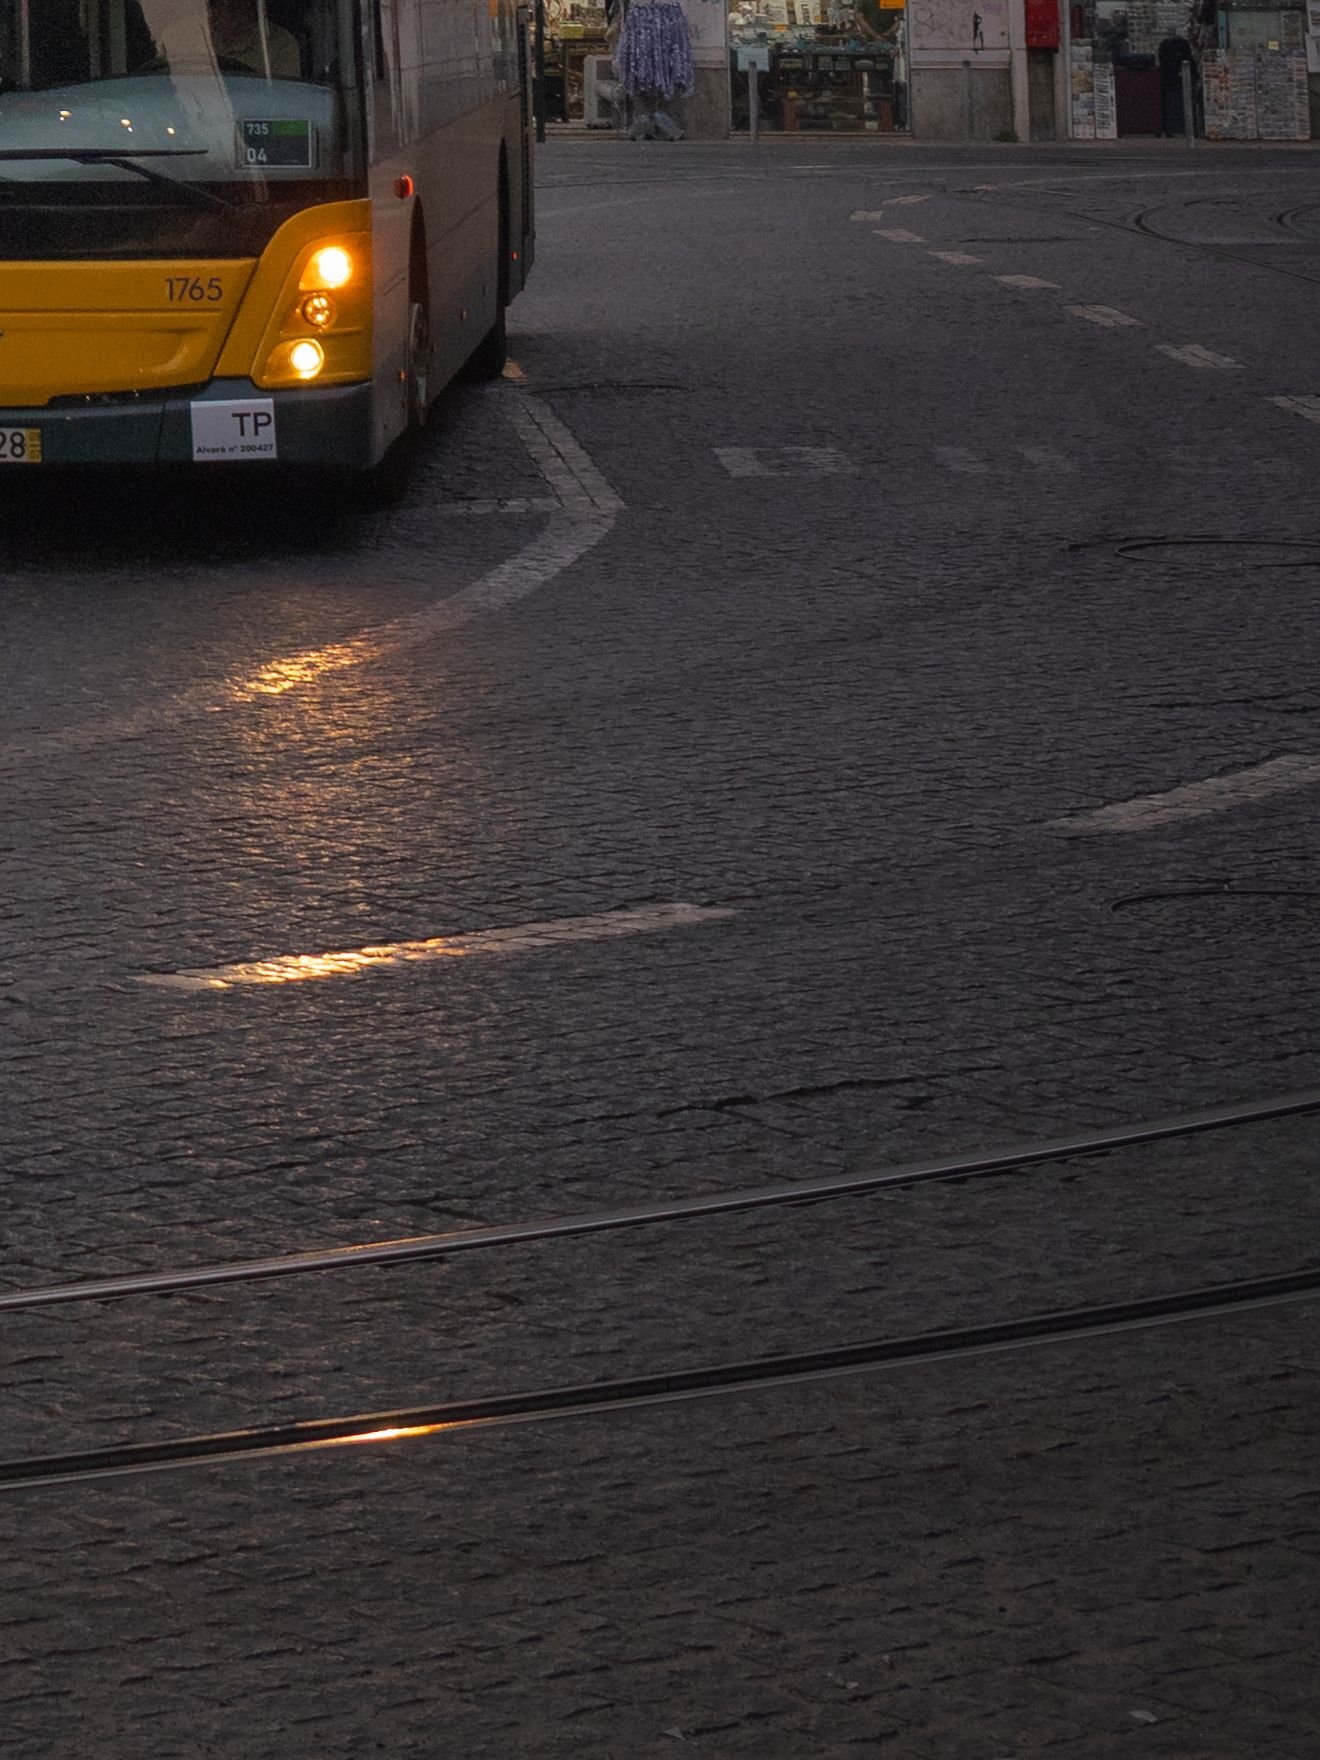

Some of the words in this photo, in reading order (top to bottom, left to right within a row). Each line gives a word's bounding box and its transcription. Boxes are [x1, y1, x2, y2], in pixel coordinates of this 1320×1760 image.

[246, 122, 269, 136] 735
[247, 147, 268, 163] 04
[165, 276, 223, 302] 1765
[231, 411, 273, 437] TP
